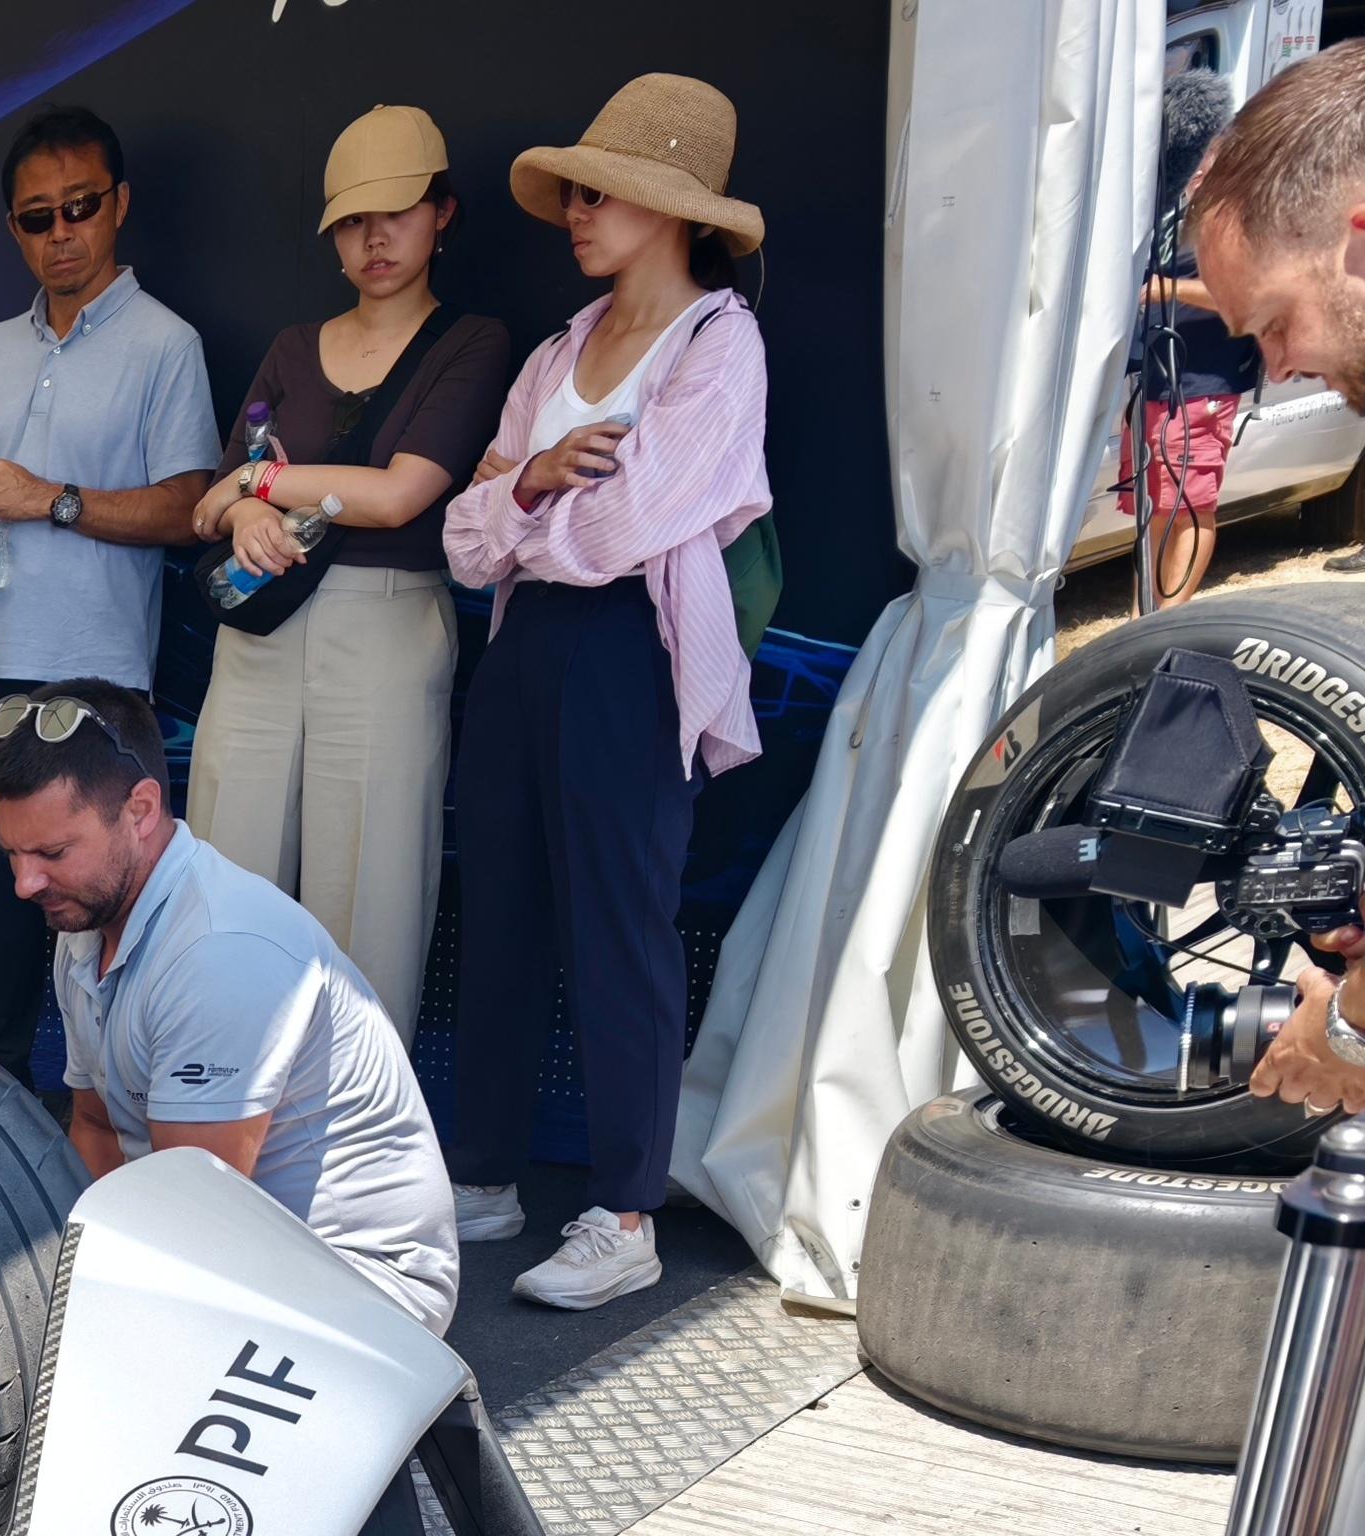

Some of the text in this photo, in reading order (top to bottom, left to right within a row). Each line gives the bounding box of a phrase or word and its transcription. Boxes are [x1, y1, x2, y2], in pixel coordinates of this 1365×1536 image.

[1232, 637, 1365, 745] BRIDGES
[948, 981, 1120, 1142] BRIDGESTONE
[175, 1339, 318, 1477] PIF
[219, 1493, 240, 1513] FUND
